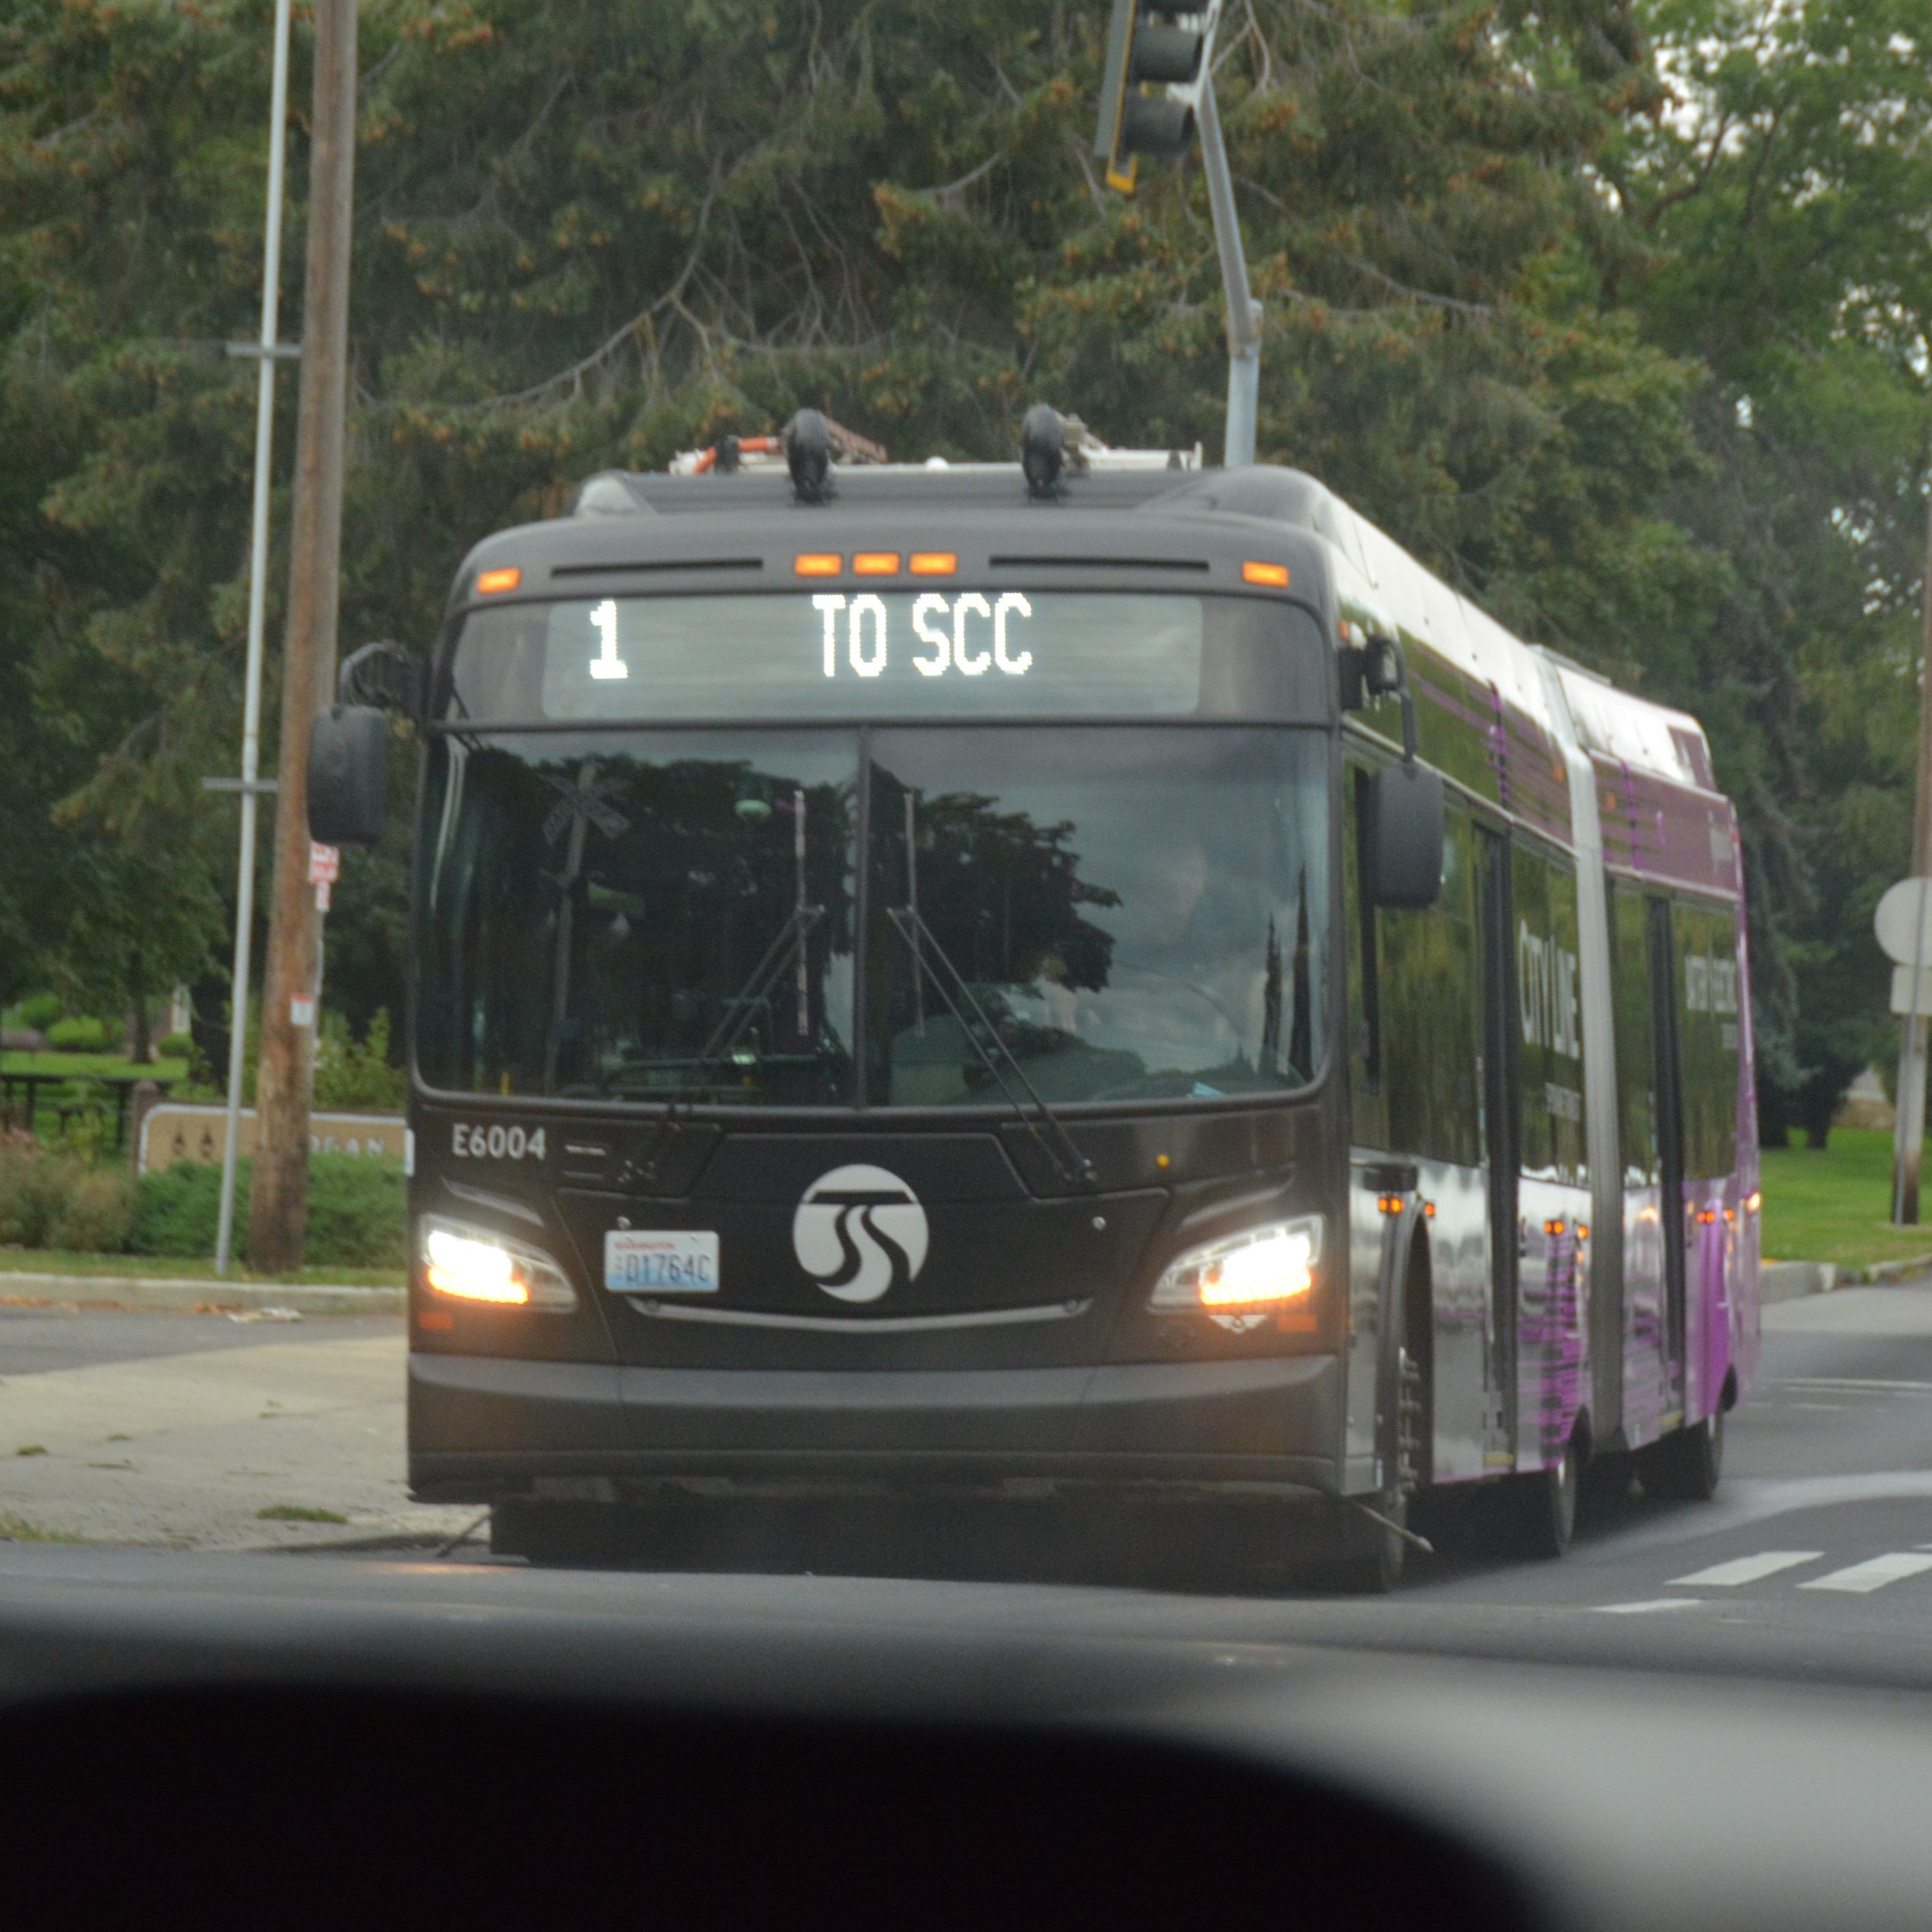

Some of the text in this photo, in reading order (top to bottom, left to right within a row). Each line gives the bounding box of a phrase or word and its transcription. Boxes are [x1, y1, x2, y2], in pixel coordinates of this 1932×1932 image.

[590, 592, 1032, 679] 1 TO SCC
[452, 1122, 546, 1161] E6004
